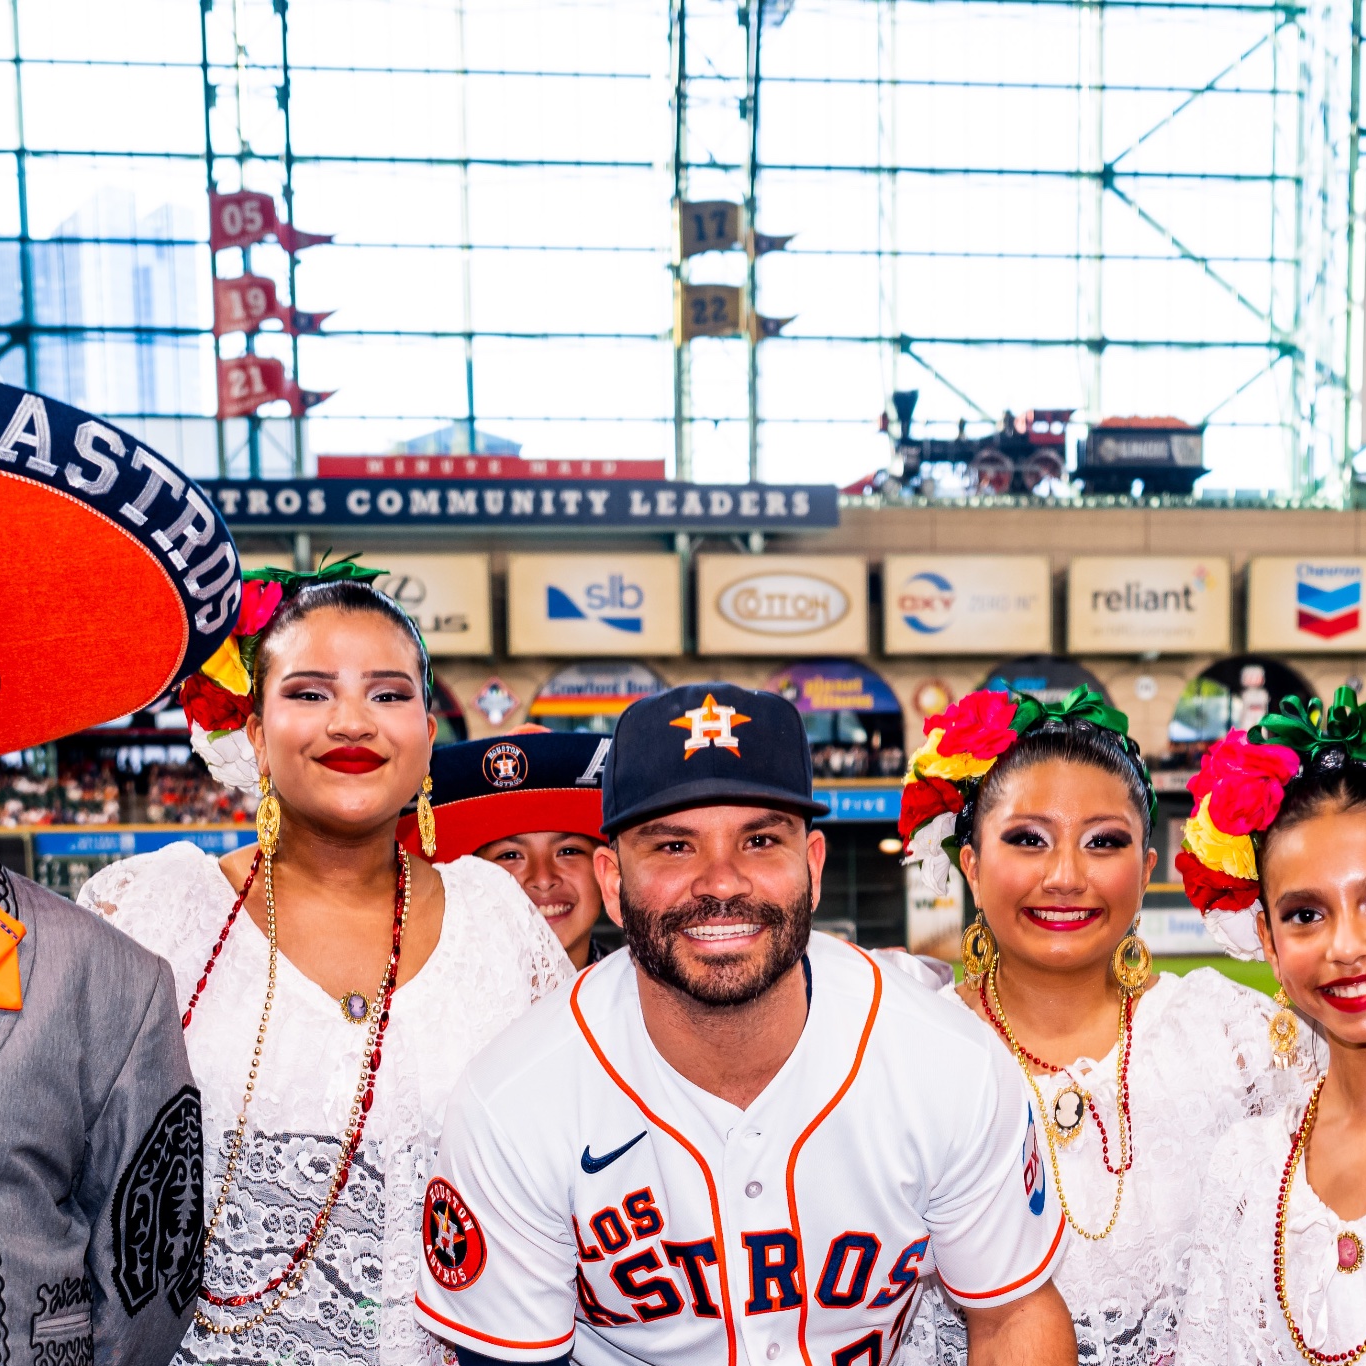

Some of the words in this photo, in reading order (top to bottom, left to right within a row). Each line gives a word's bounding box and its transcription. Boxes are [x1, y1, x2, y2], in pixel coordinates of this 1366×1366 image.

[221, 199, 263, 236] 05
[693, 210, 726, 242] 17
[229, 287, 267, 320] 19
[691, 295, 728, 325] 22
[228, 366, 267, 399] 21
[365, 460, 502, 475] MINUTE
[533, 461, 617, 475] MAID
[205, 488, 326, 515] TROS
[346, 488, 609, 516] COMMUNITY
[630, 489, 810, 517] LEADERS
[1297, 564, 1362, 578] Chevron
[586, 574, 644, 610] slb
[898, 595, 955, 612] OXY
[1092, 582, 1195, 612] reliant
[684, 705, 739, 750] H
[487, 745, 520, 759] HOUSTON
[493, 778, 523, 787] ASTROS
[429, 1184, 475, 1231] HOUSTON
[572, 1186, 664, 1263] LOS
[426, 1244, 467, 1285] ASTROS
[572, 1229, 931, 1328] ASTROS
